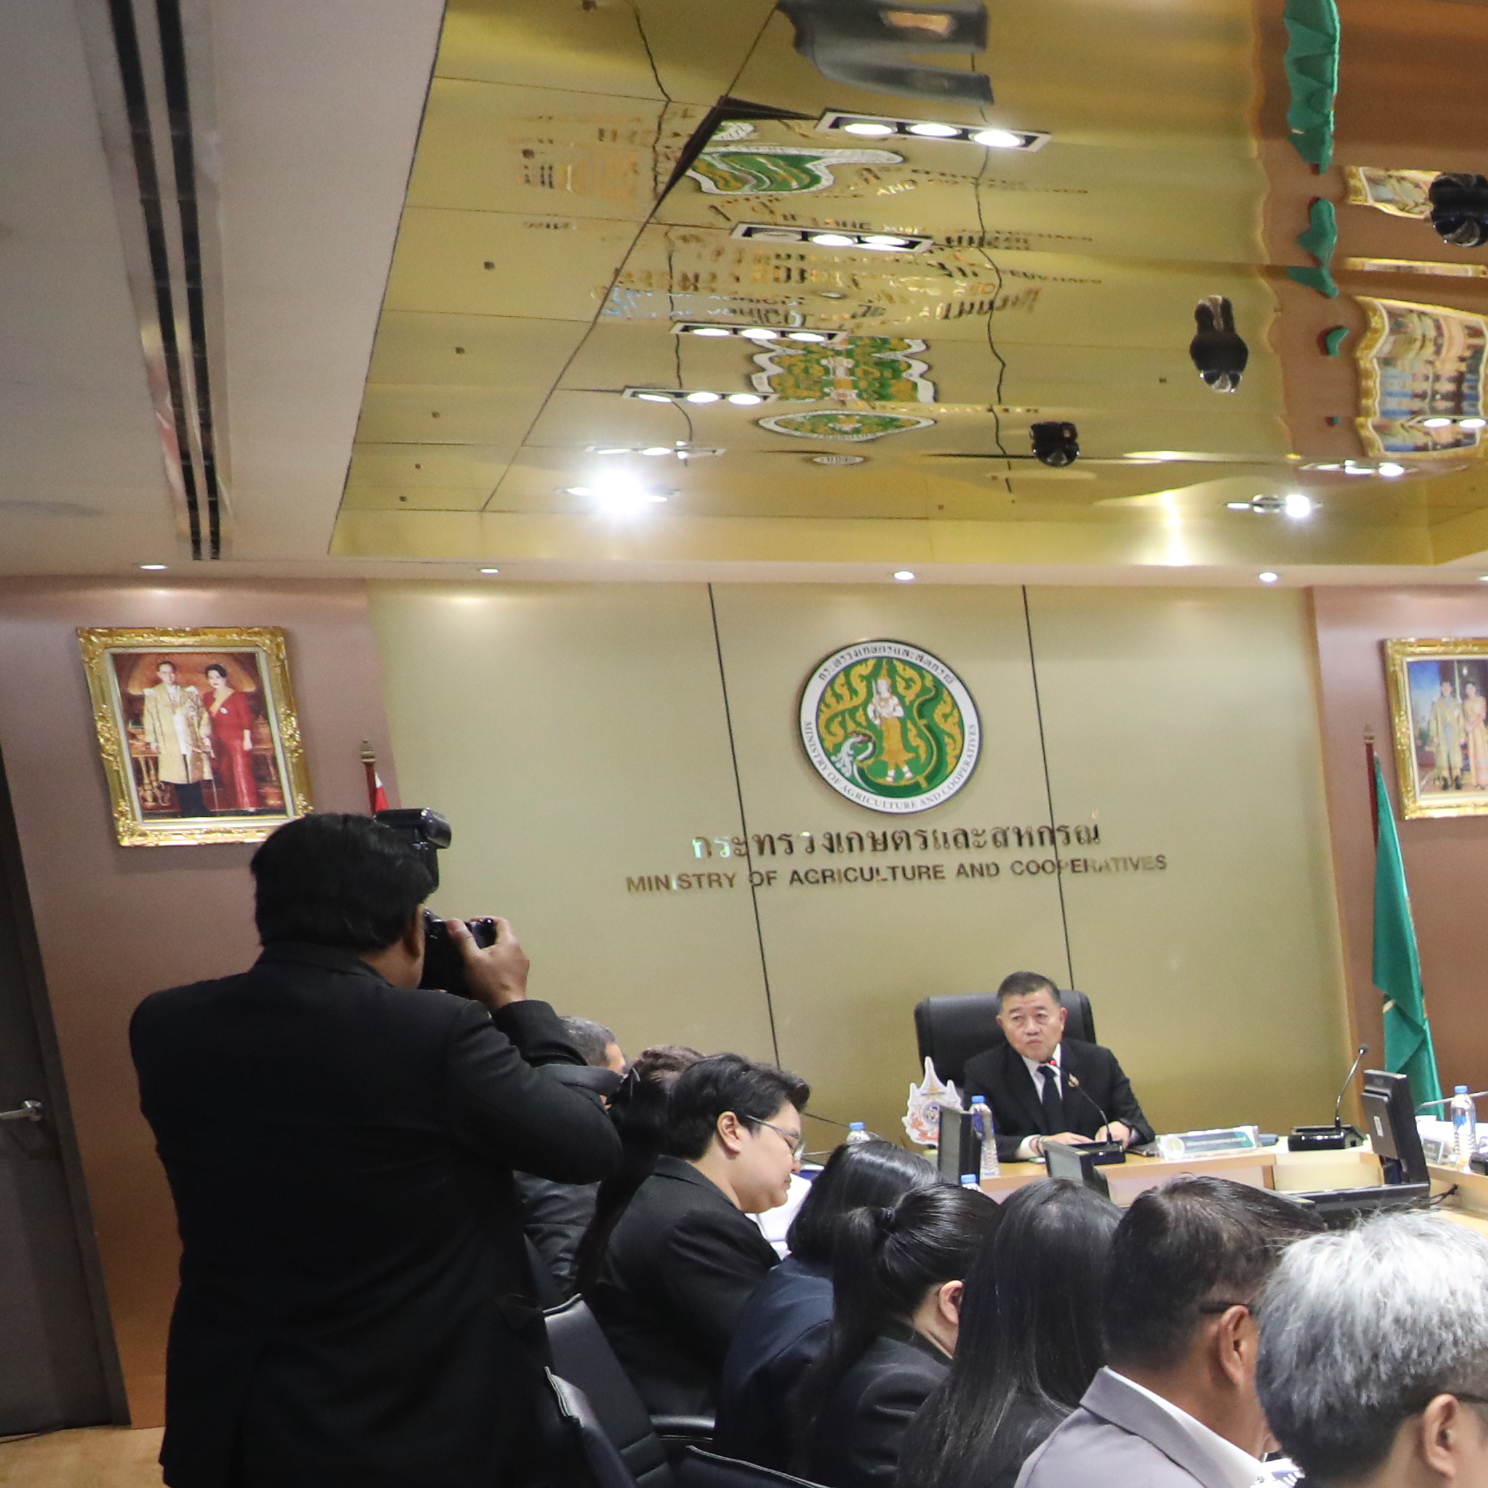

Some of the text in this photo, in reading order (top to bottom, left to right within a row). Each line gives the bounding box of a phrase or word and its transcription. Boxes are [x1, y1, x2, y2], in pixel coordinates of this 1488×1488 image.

[803, 720, 978, 811] MINISTRY OF AGRICULTURE AND COOPERATIVES
[625, 870, 737, 893] MINISTRY
[749, 869, 778, 888] OF
[788, 863, 946, 886] AGRICULTURE
[955, 860, 1000, 880] AND
